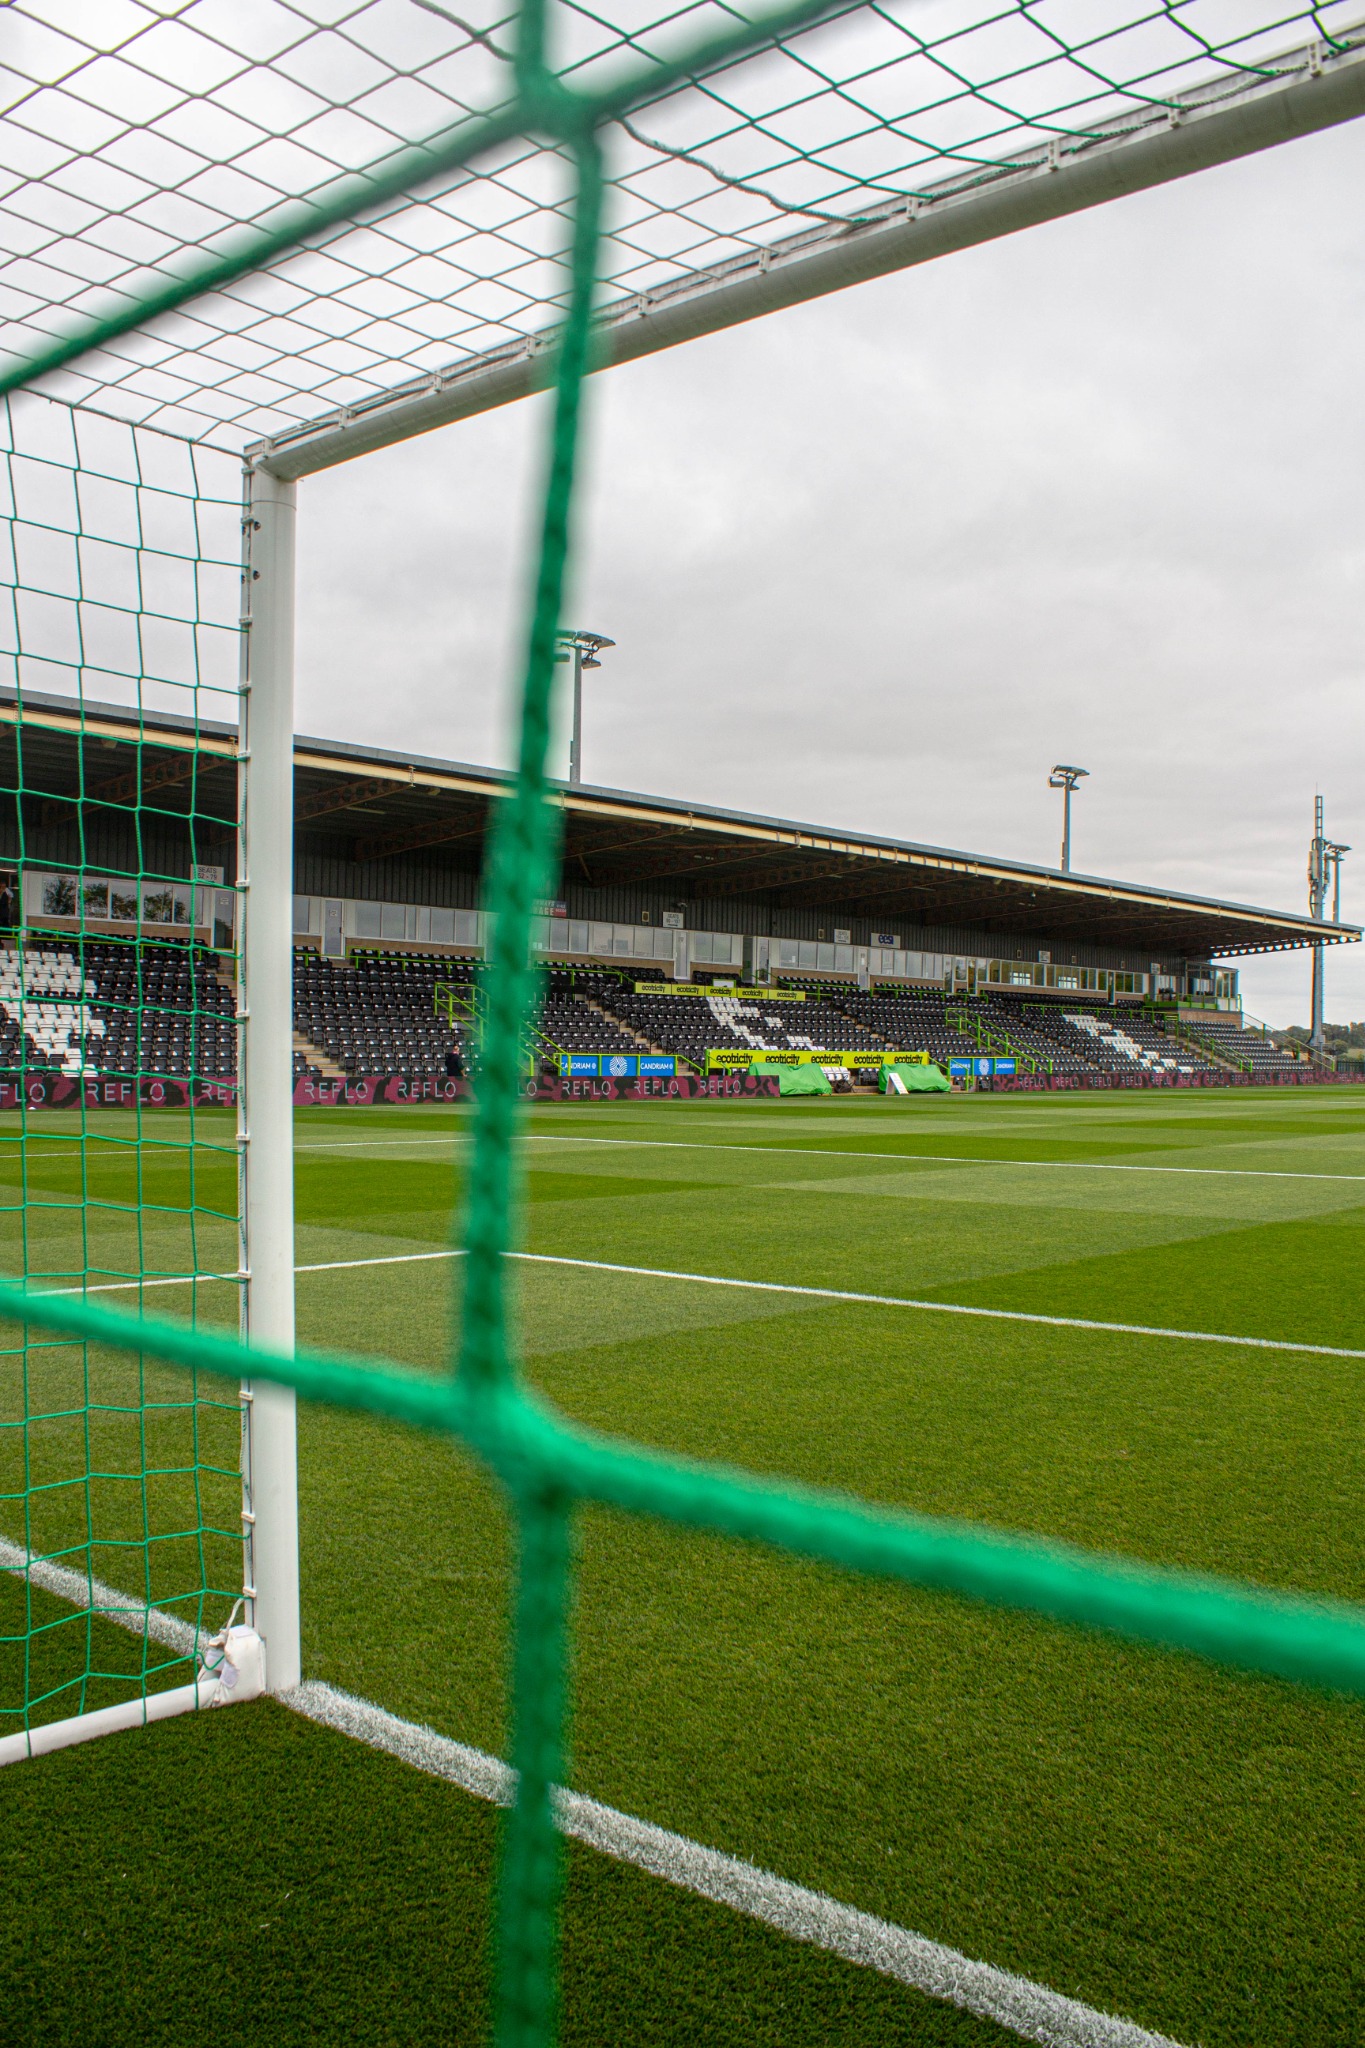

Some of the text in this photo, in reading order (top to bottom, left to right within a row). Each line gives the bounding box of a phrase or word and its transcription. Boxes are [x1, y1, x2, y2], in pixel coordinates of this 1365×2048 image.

[641, 984, 666, 993] ecotricity
[676, 986, 700, 995] ecotricity
[709, 987, 733, 997] ecotricity
[716, 1053, 753, 1065] ecotricity
[765, 1054, 800, 1066] ecotricity
[810, 1054, 844, 1066] ecotricity
[853, 1054, 883, 1065] ecotricity
[893, 1055, 923, 1065] ecotricity
[640, 1062, 668, 1070] CANDRIAM
[633, 1080, 679, 1095] REFLO
[699, 1079, 742, 1095] REFLO
[1018, 1076, 1045, 1088] REFLO
[1055, 1076, 1080, 1088] REFLO
[1089, 1076, 1112, 1087] REFLO
[0, 1083, 46, 1102] FLO
[201, 1083, 238, 1101] REF
[304, 1082, 369, 1099] REFLO
[398, 1081, 457, 1098] REFLO
[562, 1080, 612, 1096] REFLO
